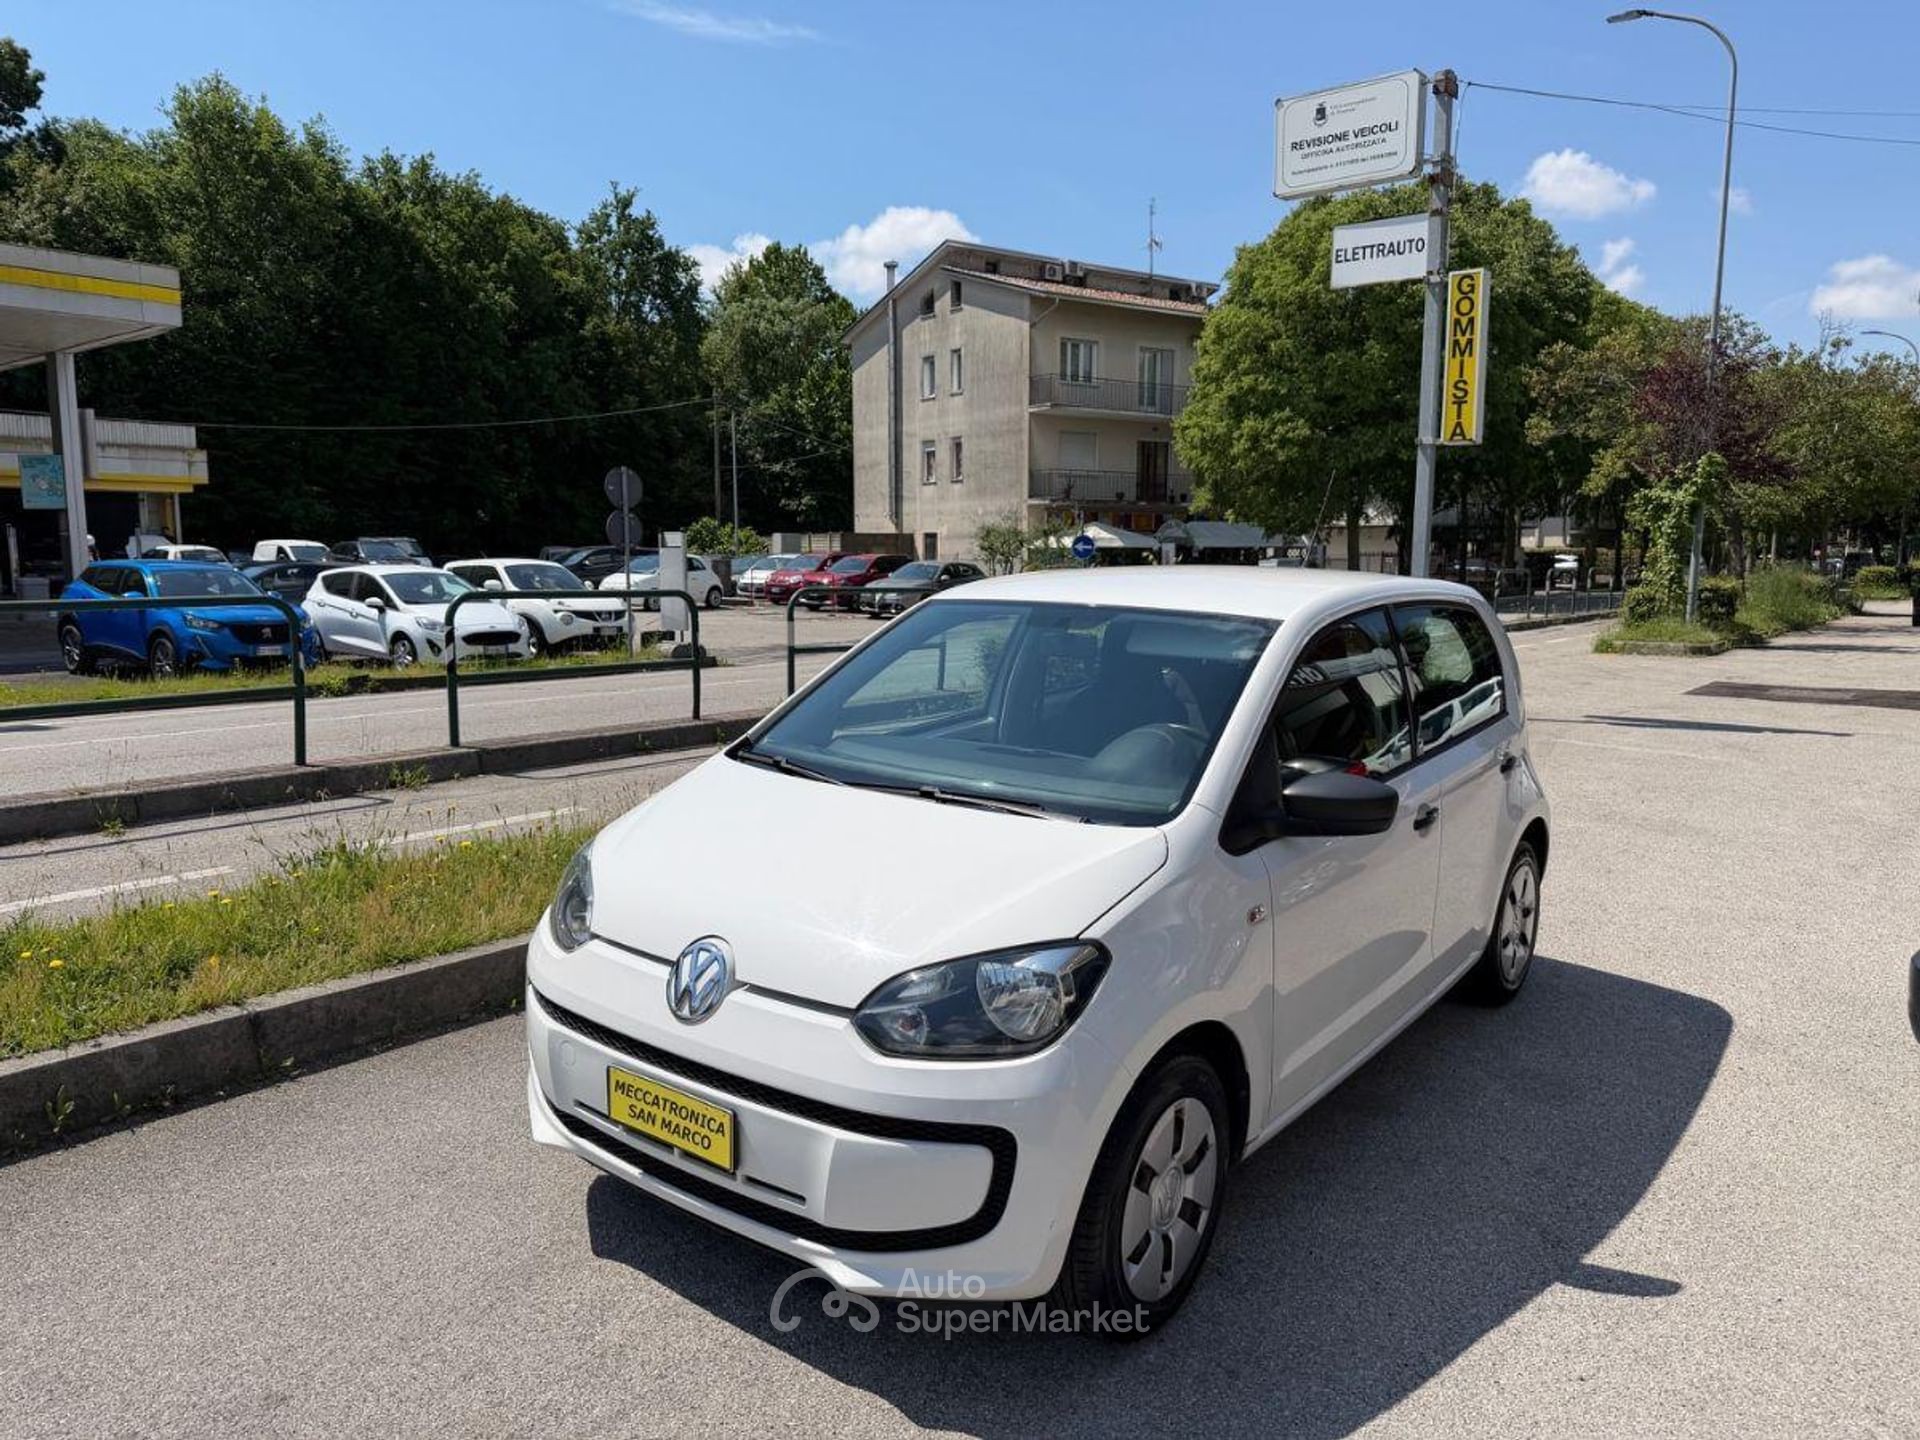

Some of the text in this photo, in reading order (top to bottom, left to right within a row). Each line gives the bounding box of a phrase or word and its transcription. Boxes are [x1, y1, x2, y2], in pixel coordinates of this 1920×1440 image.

[1291, 120, 1399, 152] REVISIONE VEICOLI
[1335, 237, 1426, 263] ELETTRAUTO
[1450, 274, 1476, 442] GOMMISTA
[614, 1079, 725, 1137] MECCATRONICA
[628, 1104, 712, 1150] SAN MARCO
